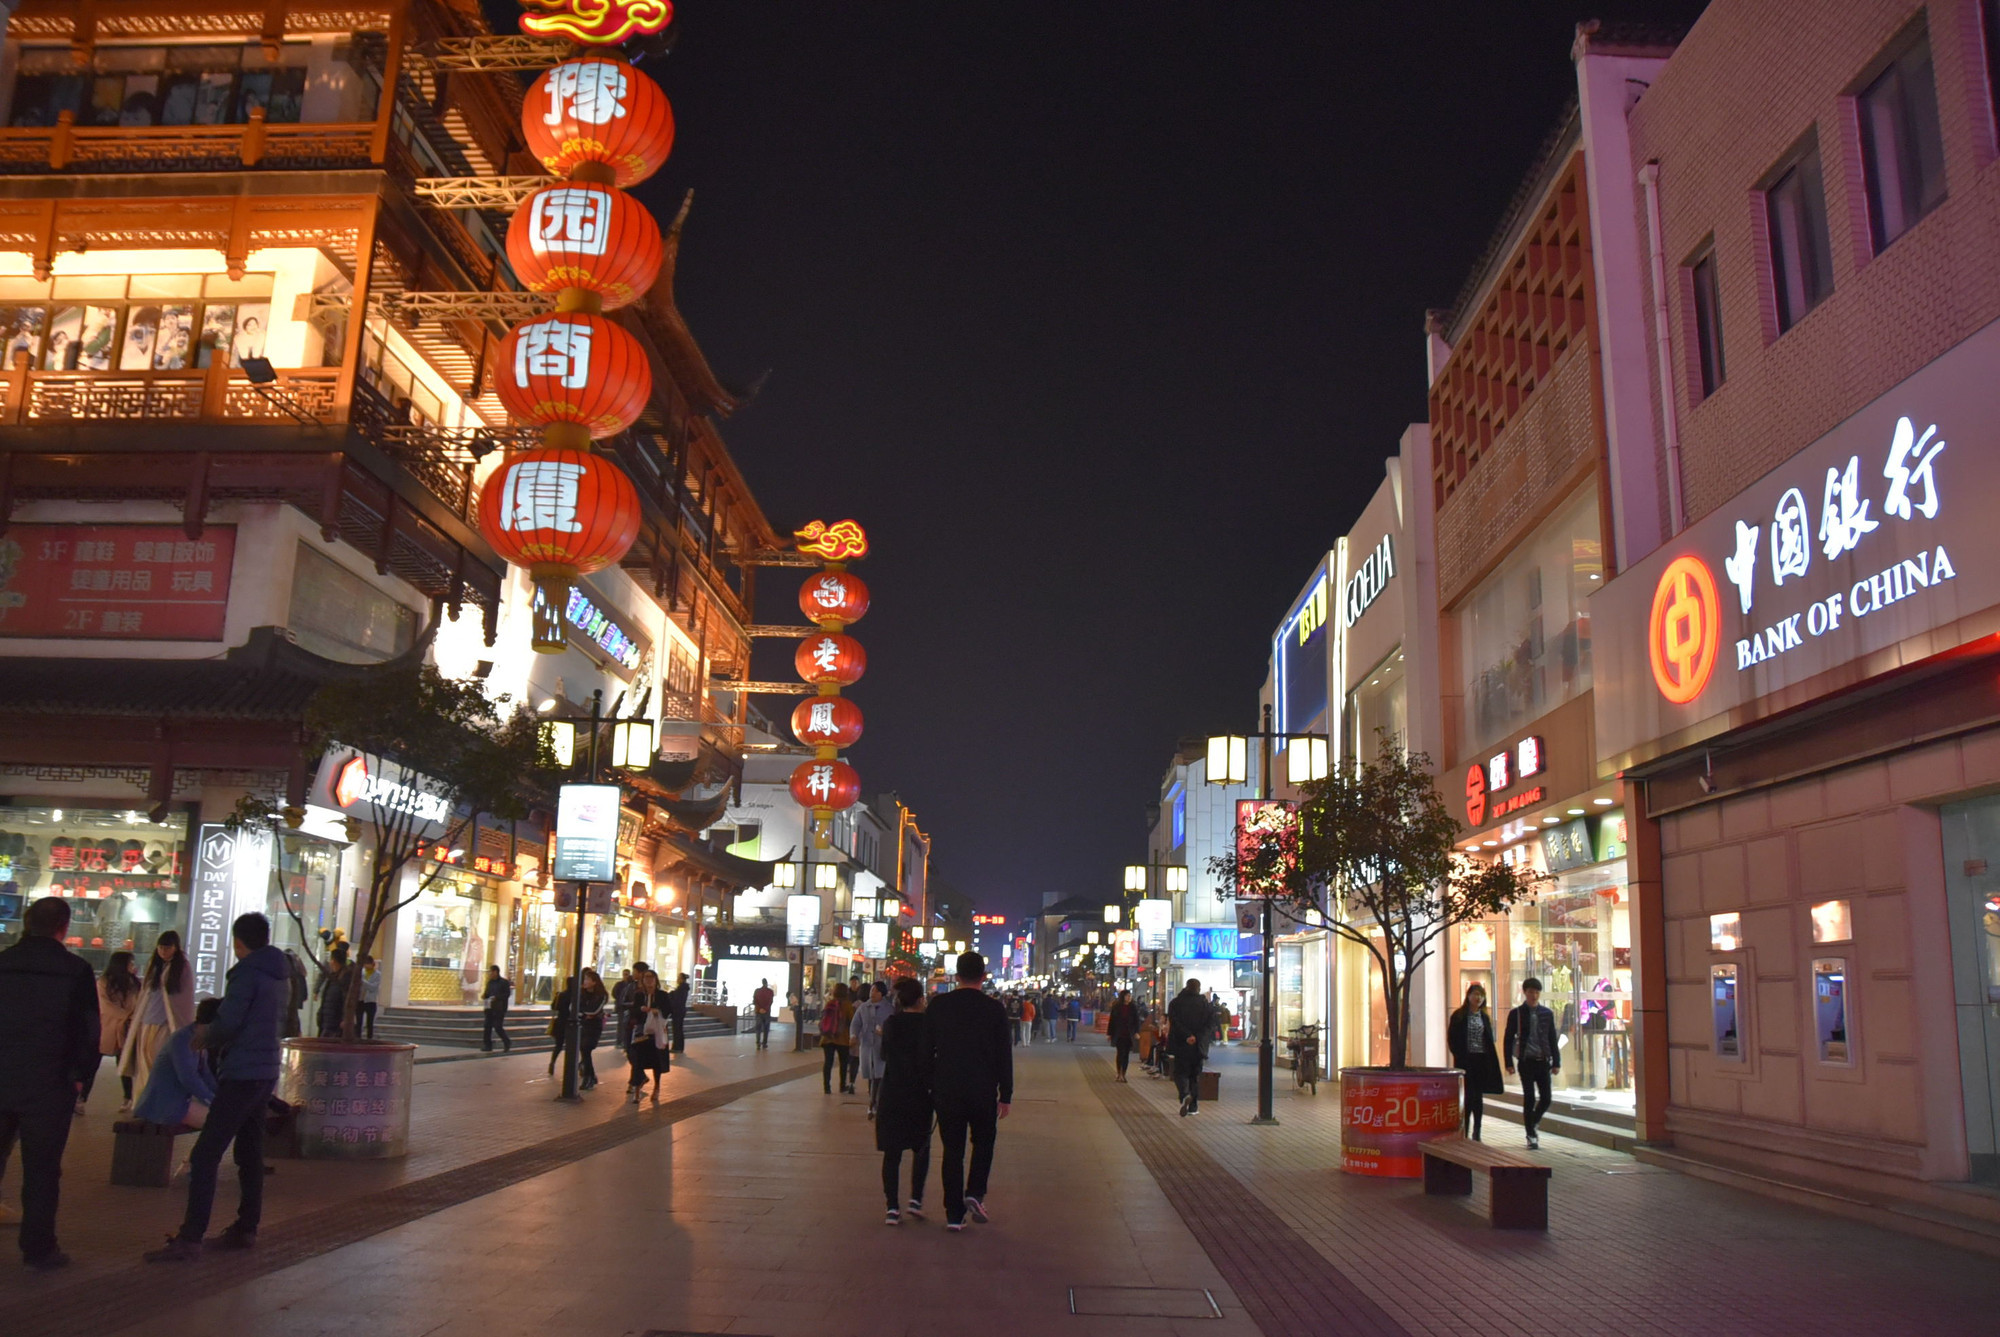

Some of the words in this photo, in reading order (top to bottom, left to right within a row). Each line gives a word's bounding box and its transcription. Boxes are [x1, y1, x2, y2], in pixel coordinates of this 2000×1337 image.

[1725, 416, 1946, 614] 中国银行
[38, 541, 68, 561] 3F
[74, 540, 116, 562] 童鞋
[132, 540, 216, 563] 婴童服饰
[70, 569, 152, 591] 婴童用品
[170, 570, 213, 593] 玩具
[1345, 533, 1394, 628] GOELIA
[63, 609, 94, 630] 2F
[100, 611, 145, 632] 童装
[1736, 613, 1803, 671] BANK
[1807, 593, 1843, 637] OF
[1849, 545, 1956, 617] CHINA
[806, 637, 840, 803] 老鳳祥
[204, 871, 229, 883] DAY
[195, 889, 225, 995] 纪念日百货
[729, 944, 770, 956] KAMA
